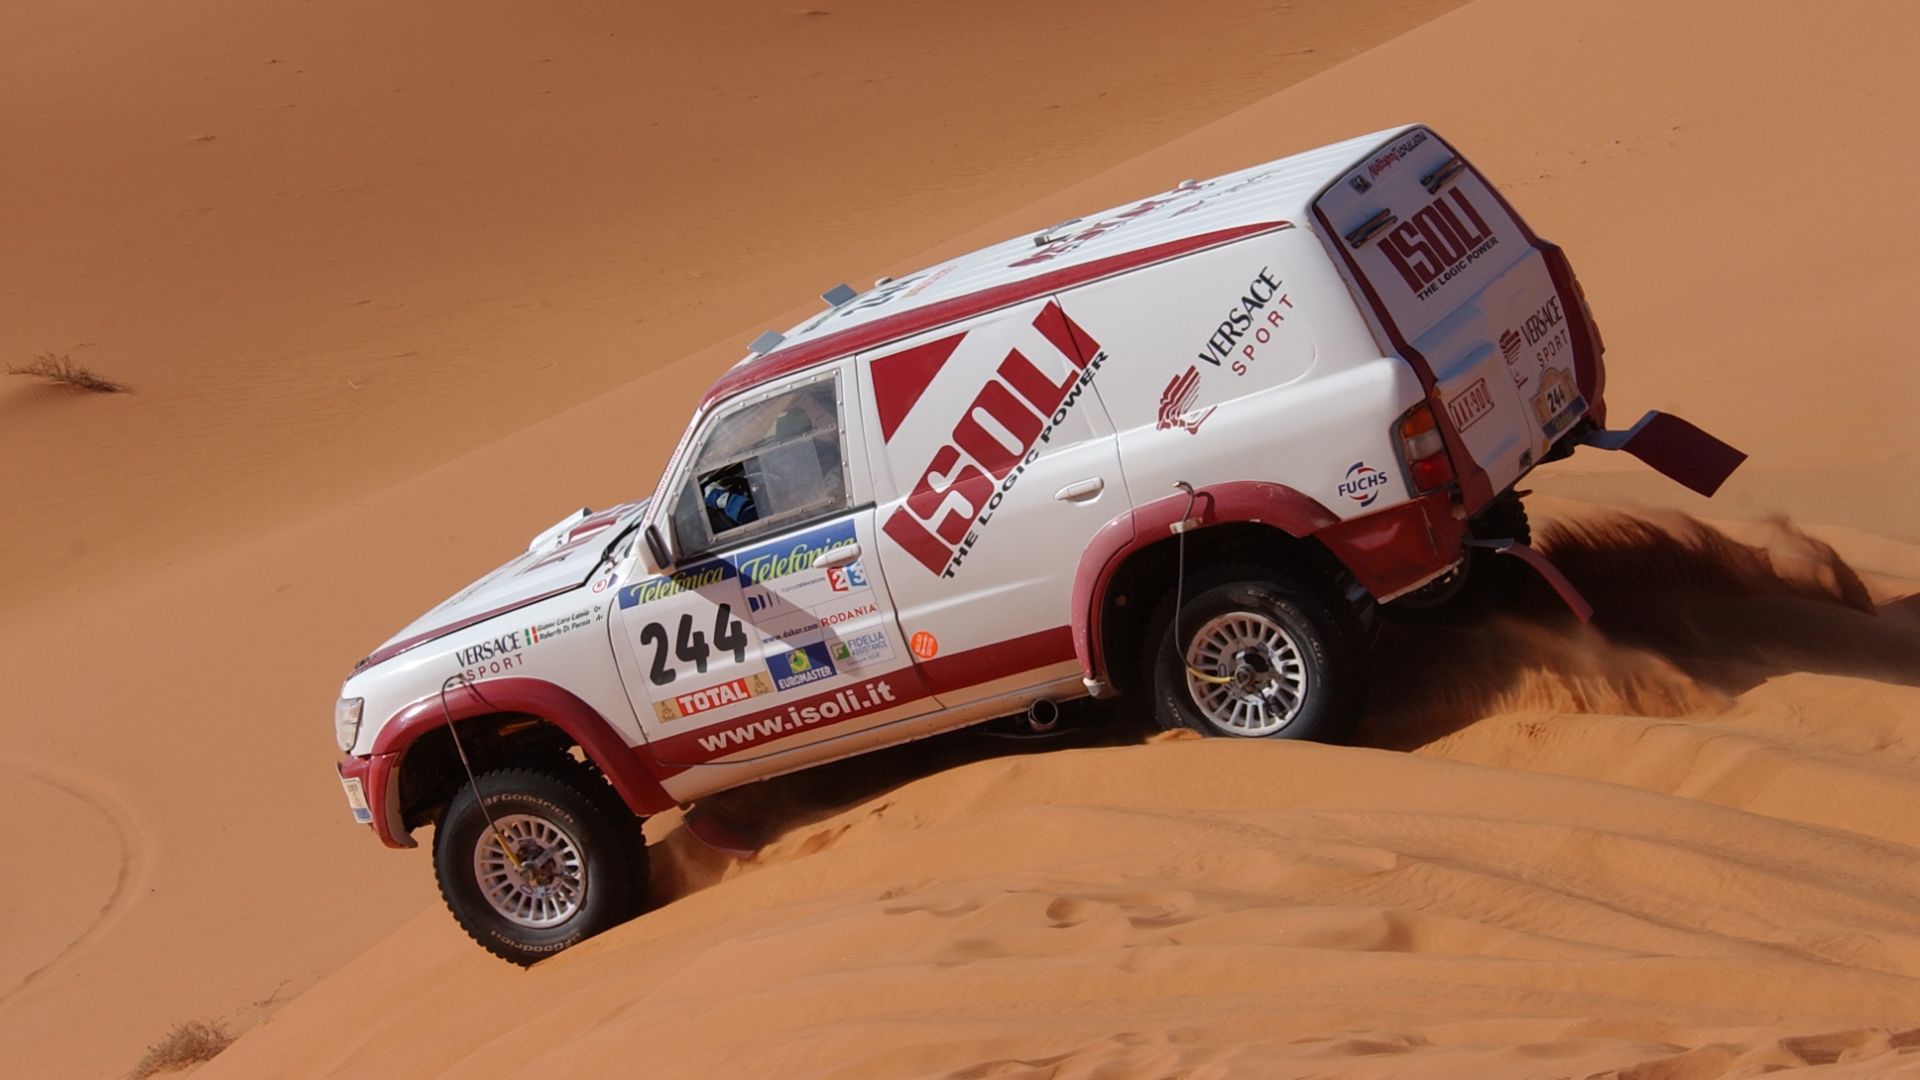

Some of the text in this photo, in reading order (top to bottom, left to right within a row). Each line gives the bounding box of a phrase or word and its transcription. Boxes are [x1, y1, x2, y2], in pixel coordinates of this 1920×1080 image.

[1376, 186, 1493, 294] ISOLI
[1417, 237, 1500, 301] THE LOGIC POWER
[1198, 266, 1283, 369] VERSACE
[1231, 294, 1294, 377] SPORT
[1521, 295, 1563, 347] VERSACE
[1537, 329, 1568, 368] SPORT
[1547, 384, 1567, 413] 244
[881, 299, 1101, 577] ISOLI
[942, 351, 1109, 580] THE LOGIC POWER
[1338, 471, 1388, 497] FUCHS
[820, 604, 878, 627] RODANIA
[455, 630, 522, 668] VERSACE
[640, 602, 748, 686] 244
[848, 631, 885, 649] FIDELIA
[466, 652, 523, 681] SPORT
[778, 665, 833, 690] EUROMASTER
[678, 682, 749, 714] TOTAL
[698, 680, 896, 752] www.isoli.it
